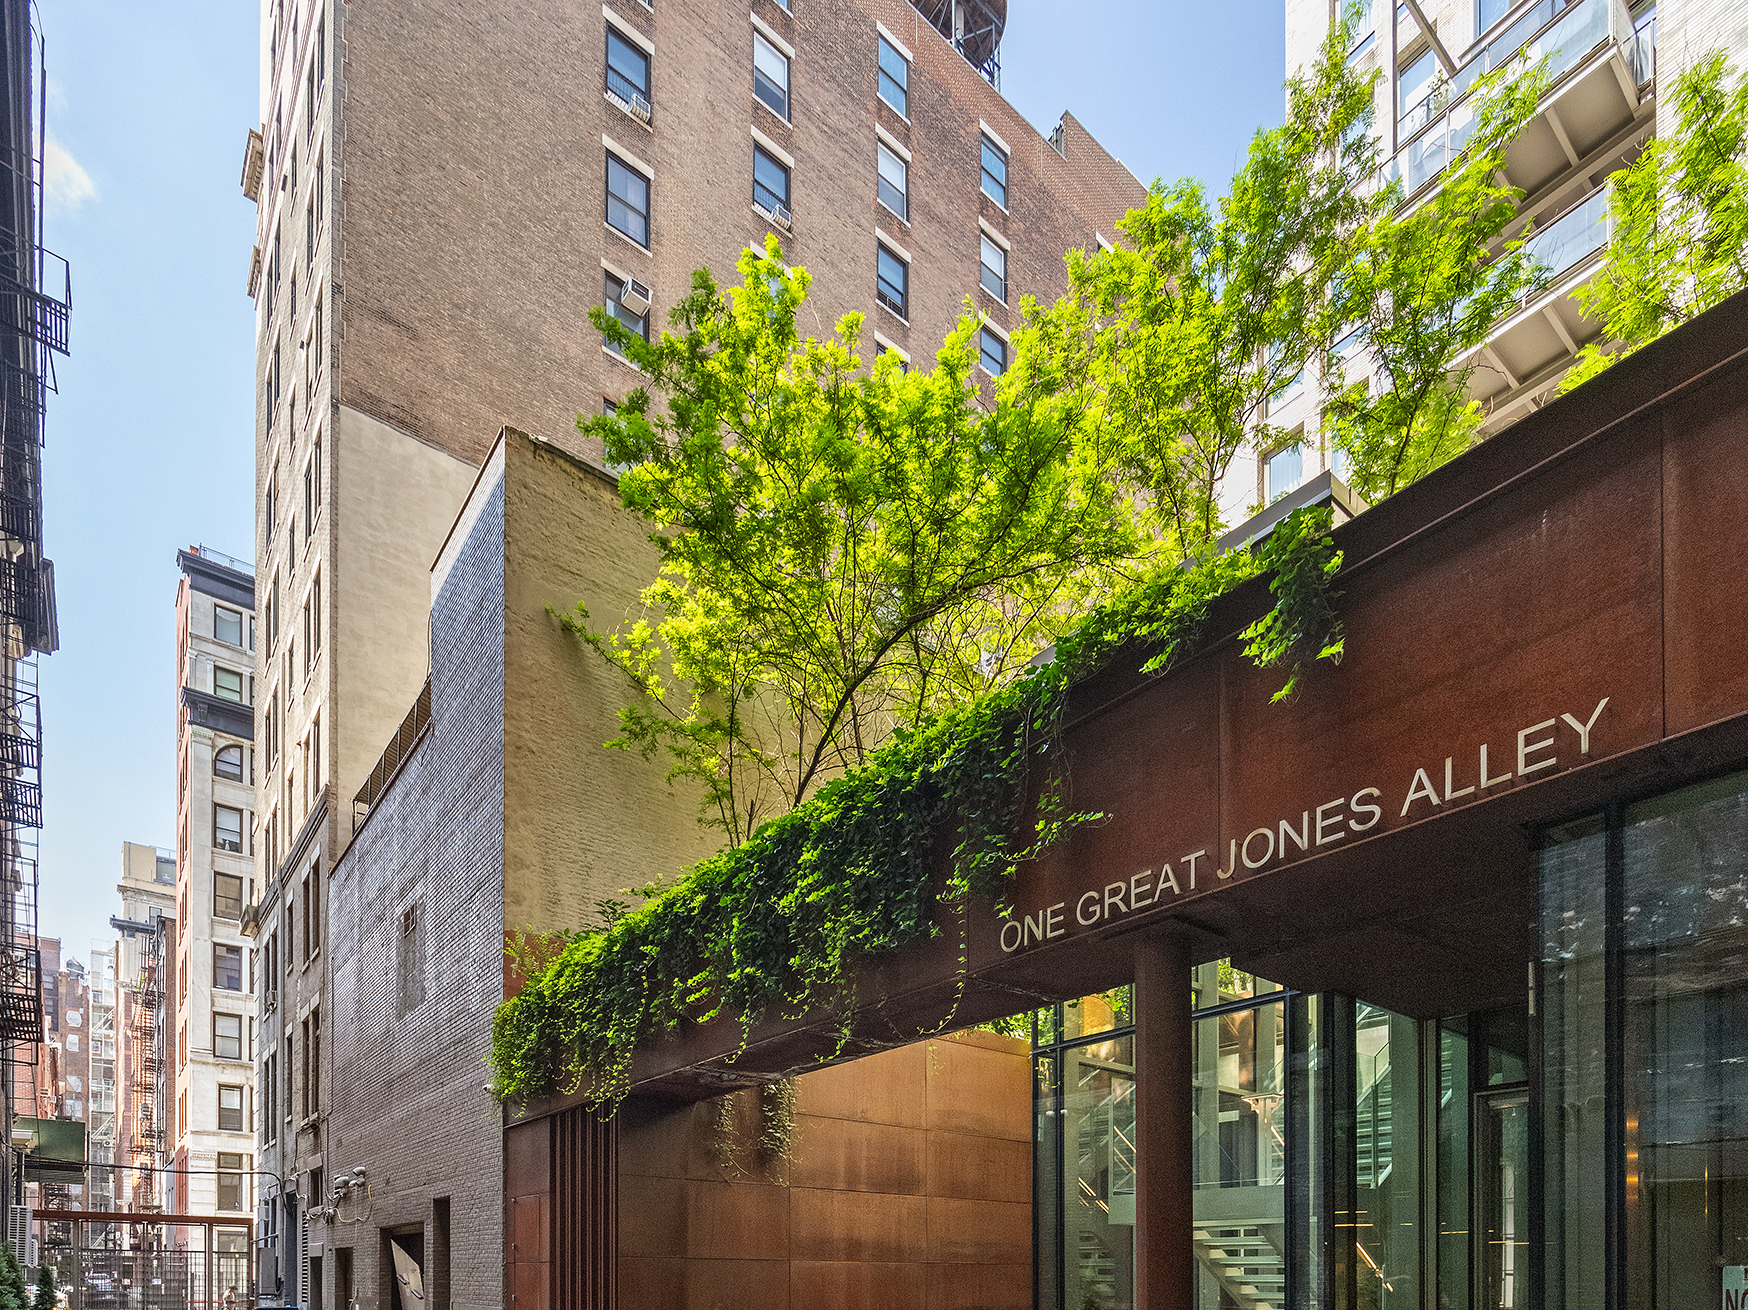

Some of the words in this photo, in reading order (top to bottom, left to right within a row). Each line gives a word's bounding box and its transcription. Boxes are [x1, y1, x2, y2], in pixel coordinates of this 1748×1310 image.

[1000, 902, 1065, 953] ONE
[1077, 850, 1206, 927] GREAT
[1217, 787, 1382, 880] JONES
[1400, 696, 1611, 817] ALLEY
